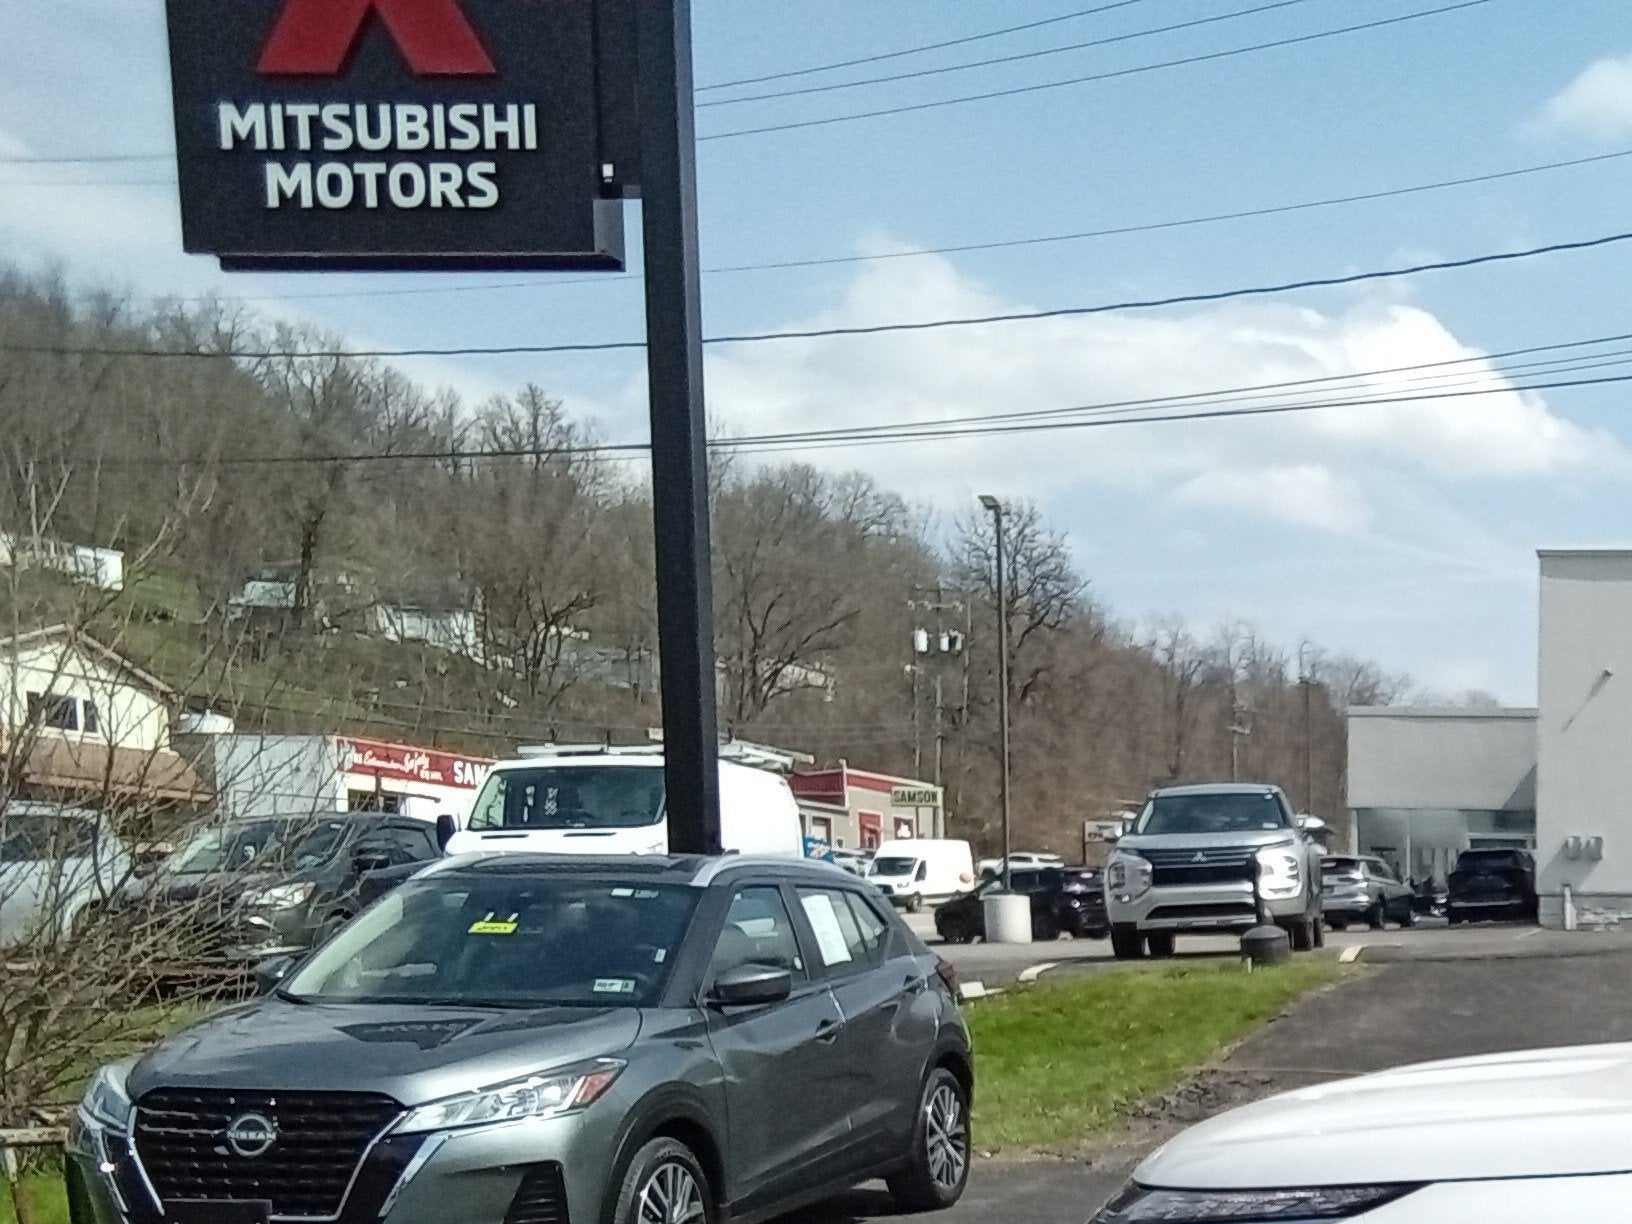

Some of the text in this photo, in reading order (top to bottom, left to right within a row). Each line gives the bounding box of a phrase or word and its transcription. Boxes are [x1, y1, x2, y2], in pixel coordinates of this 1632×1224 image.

[218, 102, 537, 151] MITSUBISHI
[265, 161, 499, 208] MOTORS
[453, 760, 494, 786] SAM
[227, 1130, 277, 1141] NISSAN
